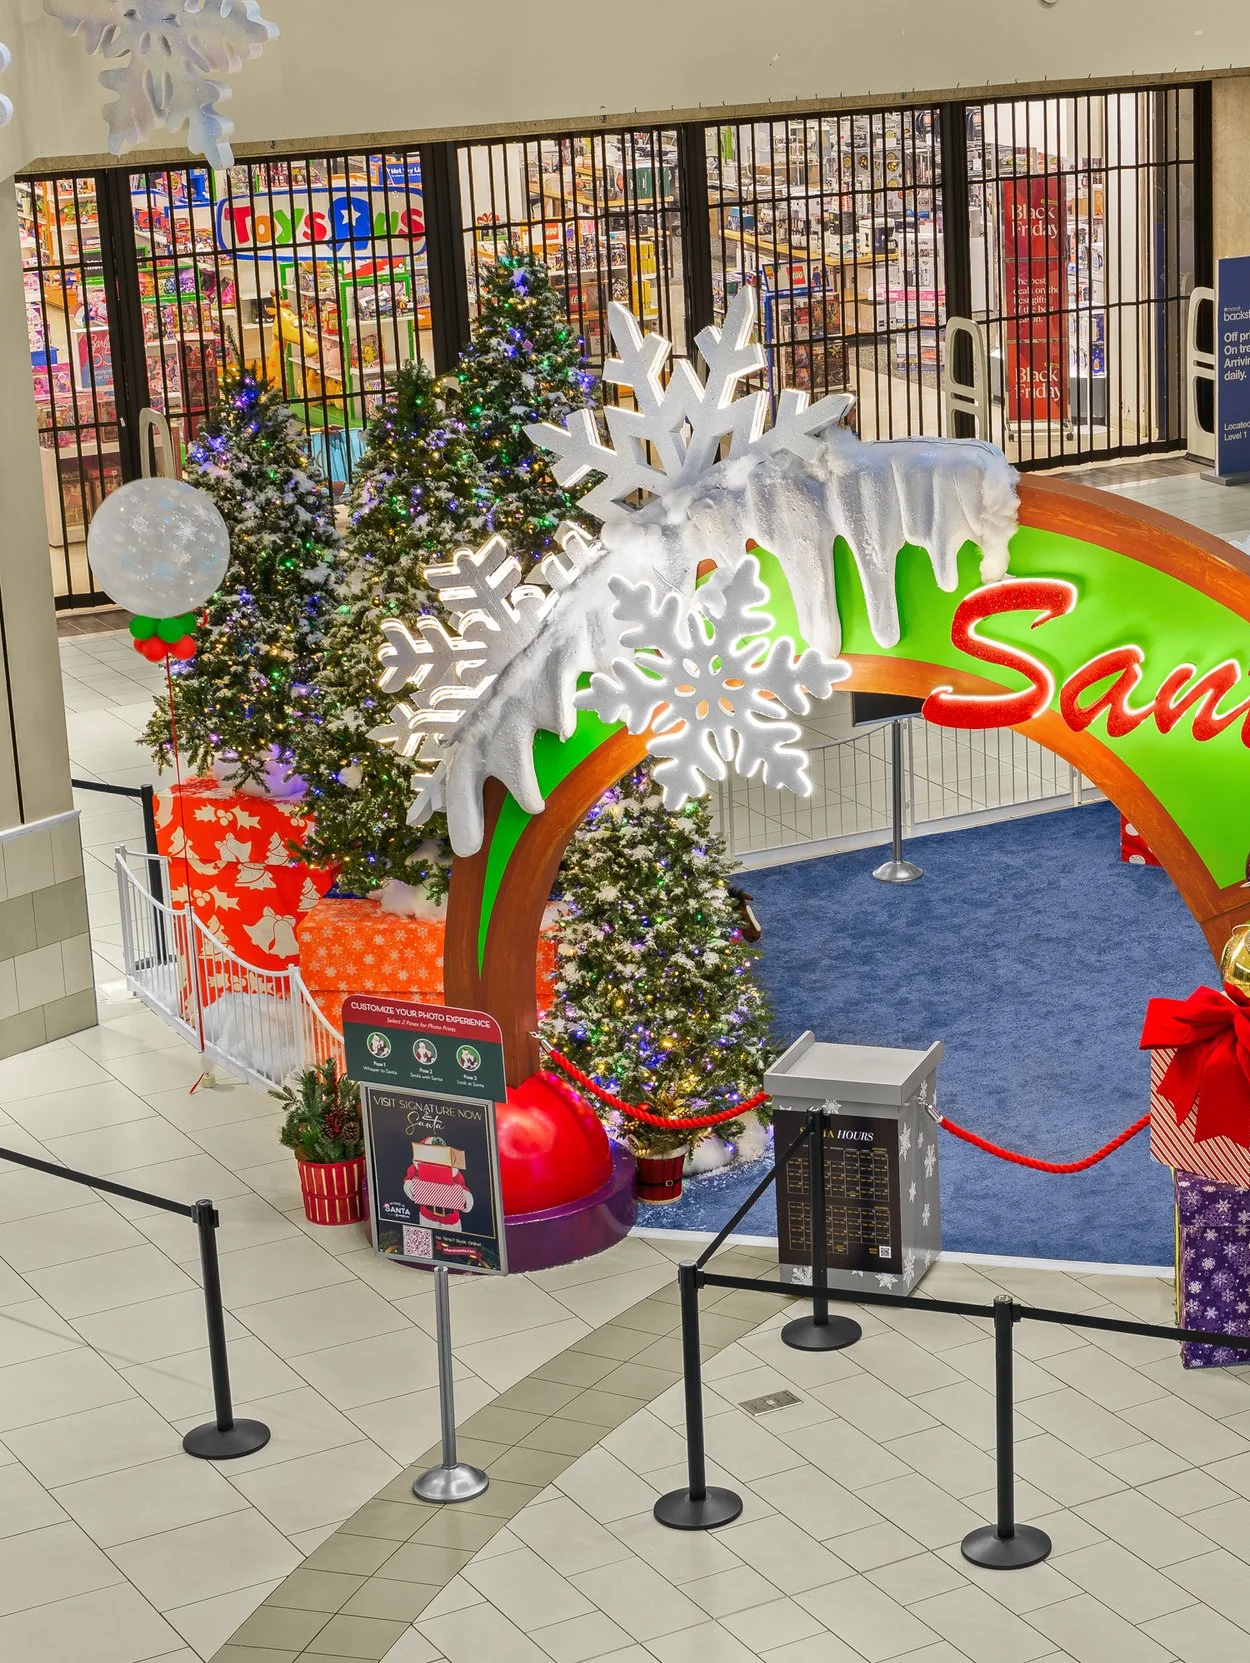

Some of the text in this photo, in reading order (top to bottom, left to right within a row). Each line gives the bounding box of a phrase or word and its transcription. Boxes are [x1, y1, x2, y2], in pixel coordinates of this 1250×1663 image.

[1012, 203, 1055, 220] Black
[1012, 278, 1028, 286] he
[1013, 286, 1034, 295] eal
[570, 294, 586, 304] LEO
[1224, 332, 1238, 343] Off
[1224, 345, 1237, 356] On
[1015, 366, 1058, 382] Black
[1224, 370, 1247, 381] daily.
[1224, 432, 1242, 442] Level
[350, 1002, 491, 1028] CUSTOMIZE YOUR PHOTO EXPERIENCE
[373, 1095, 482, 1120] VISIT SIGNATURE NOW
[406, 1111, 444, 1135] Santa
[837, 1130, 874, 1142] HOURS
[384, 1204, 411, 1215] SANTA
